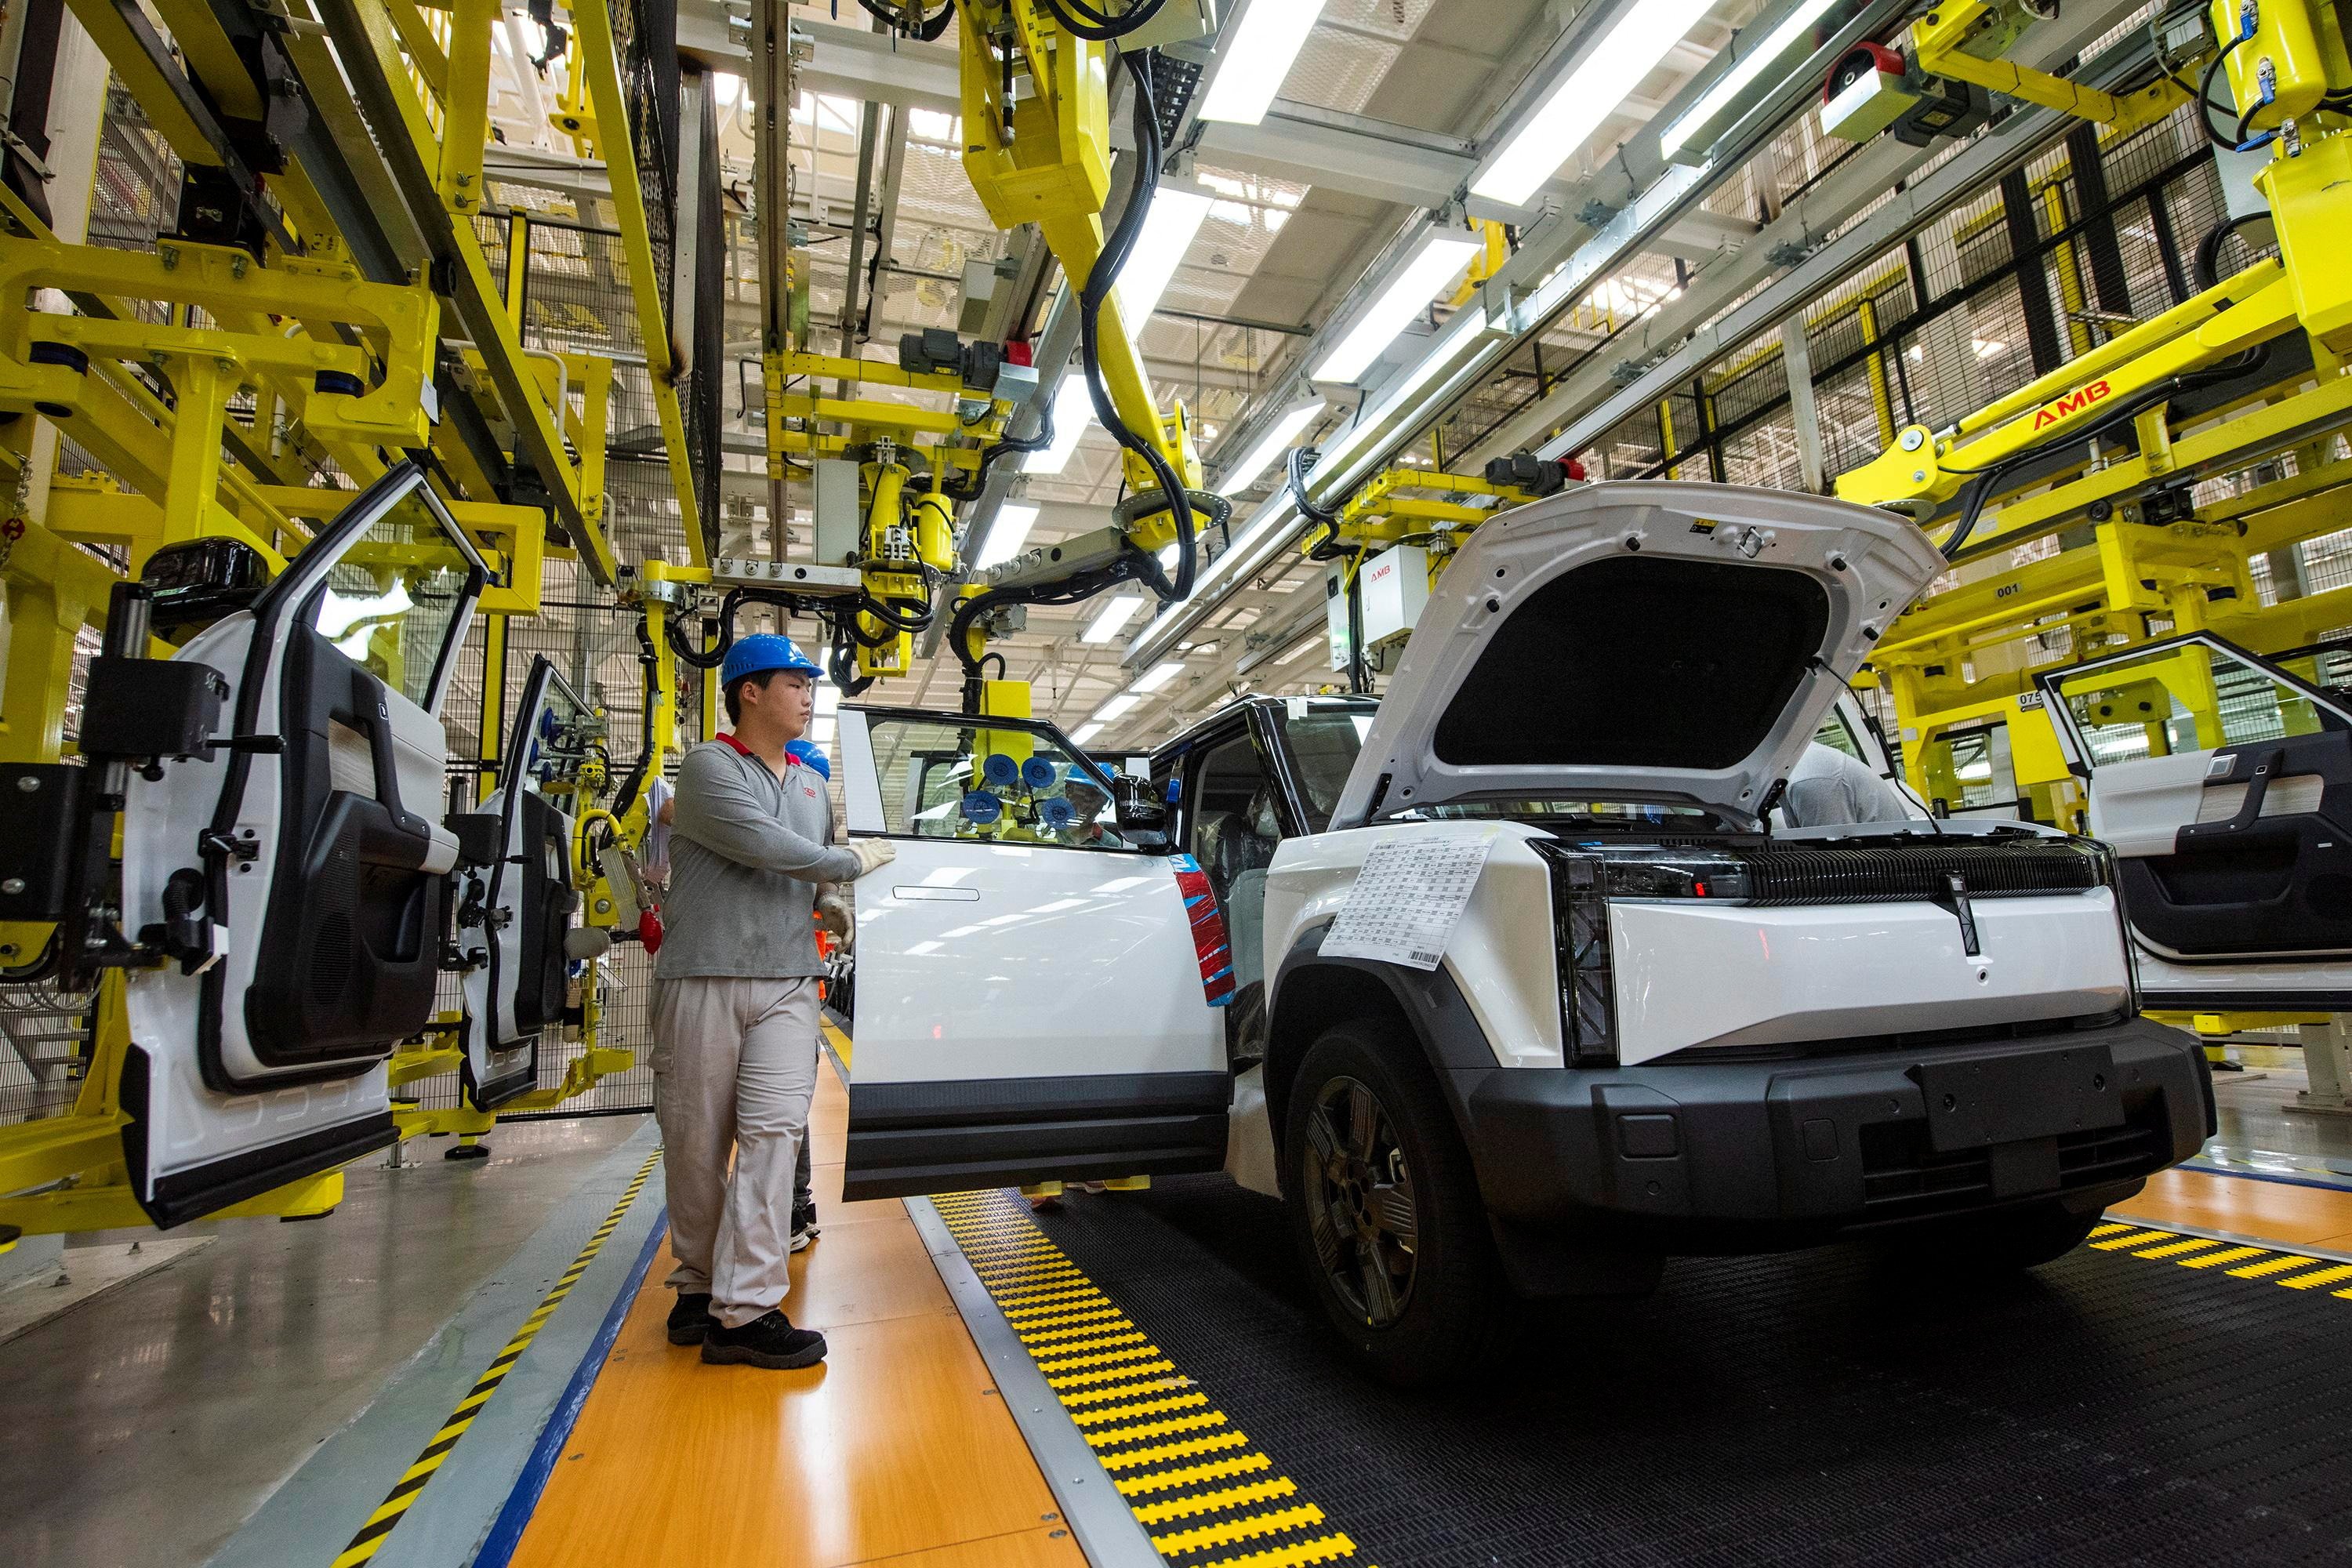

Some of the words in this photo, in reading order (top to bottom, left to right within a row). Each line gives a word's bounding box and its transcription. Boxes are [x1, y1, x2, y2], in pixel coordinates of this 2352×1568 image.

[2034, 380, 2111, 430] AMB
[1370, 564, 1391, 583] AMB
[1998, 583, 2017, 597] 001
[2020, 691, 2042, 704] 075
